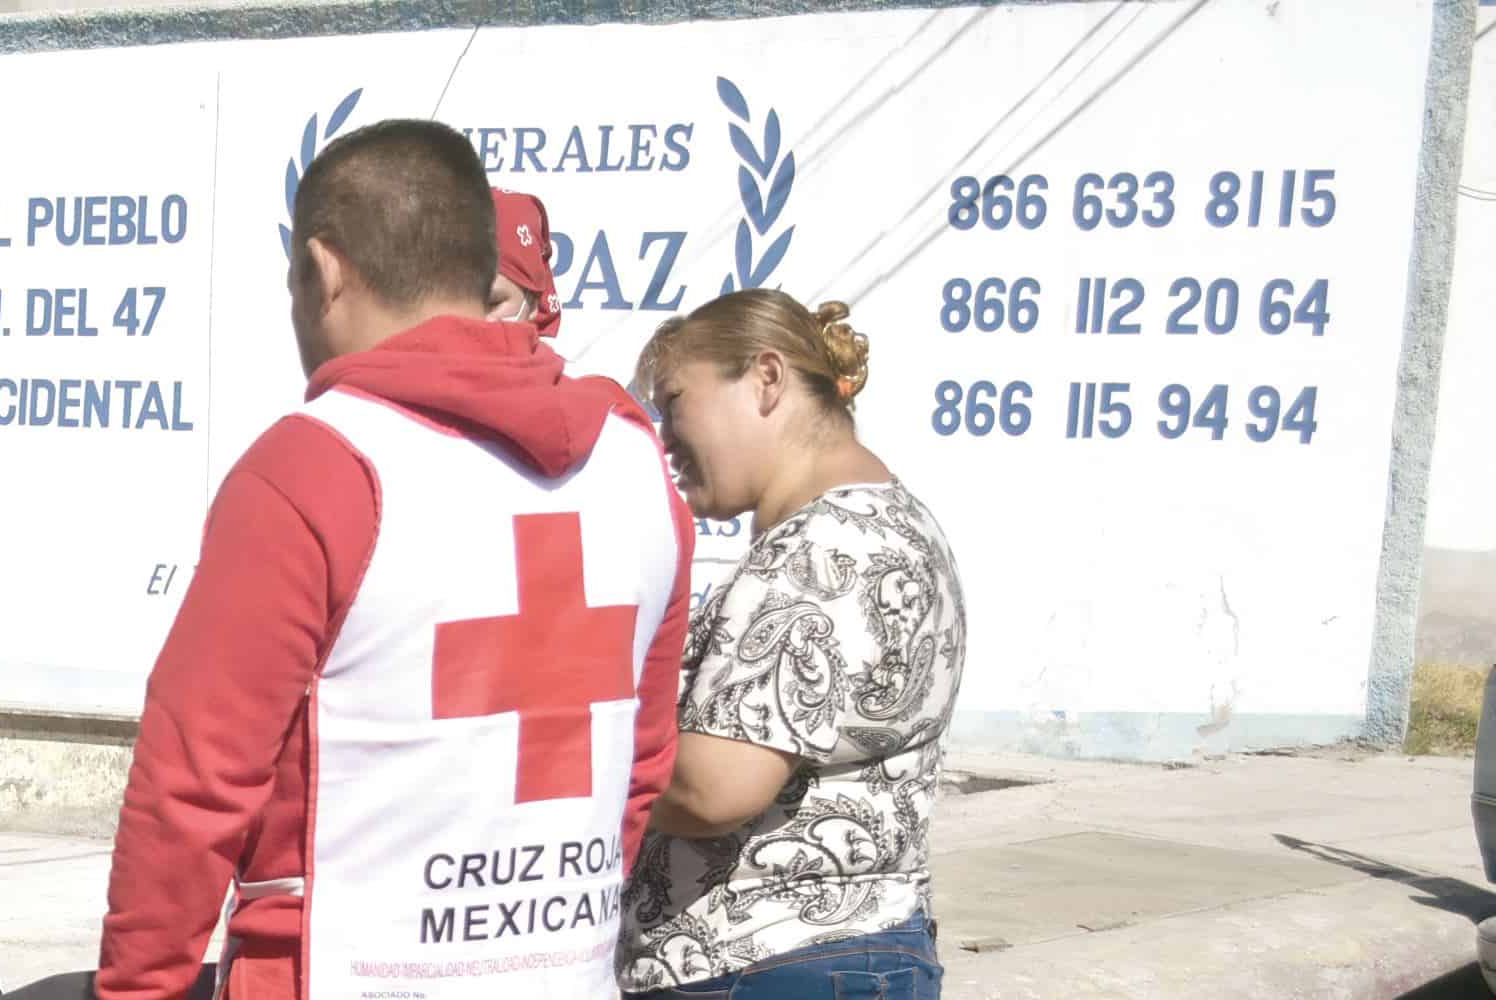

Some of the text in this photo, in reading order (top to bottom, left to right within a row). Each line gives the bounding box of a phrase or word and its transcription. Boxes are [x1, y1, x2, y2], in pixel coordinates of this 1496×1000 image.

[26, 193, 188, 247] PUEBLO
[947, 169, 1336, 232] 866 633 8115
[25, 287, 99, 337] DEL
[111, 286, 167, 337] 47
[940, 276, 1330, 337] 866 112 20 64
[931, 379, 1318, 445] 866 115 94 94
[423, 845, 545, 891] CRUZ
